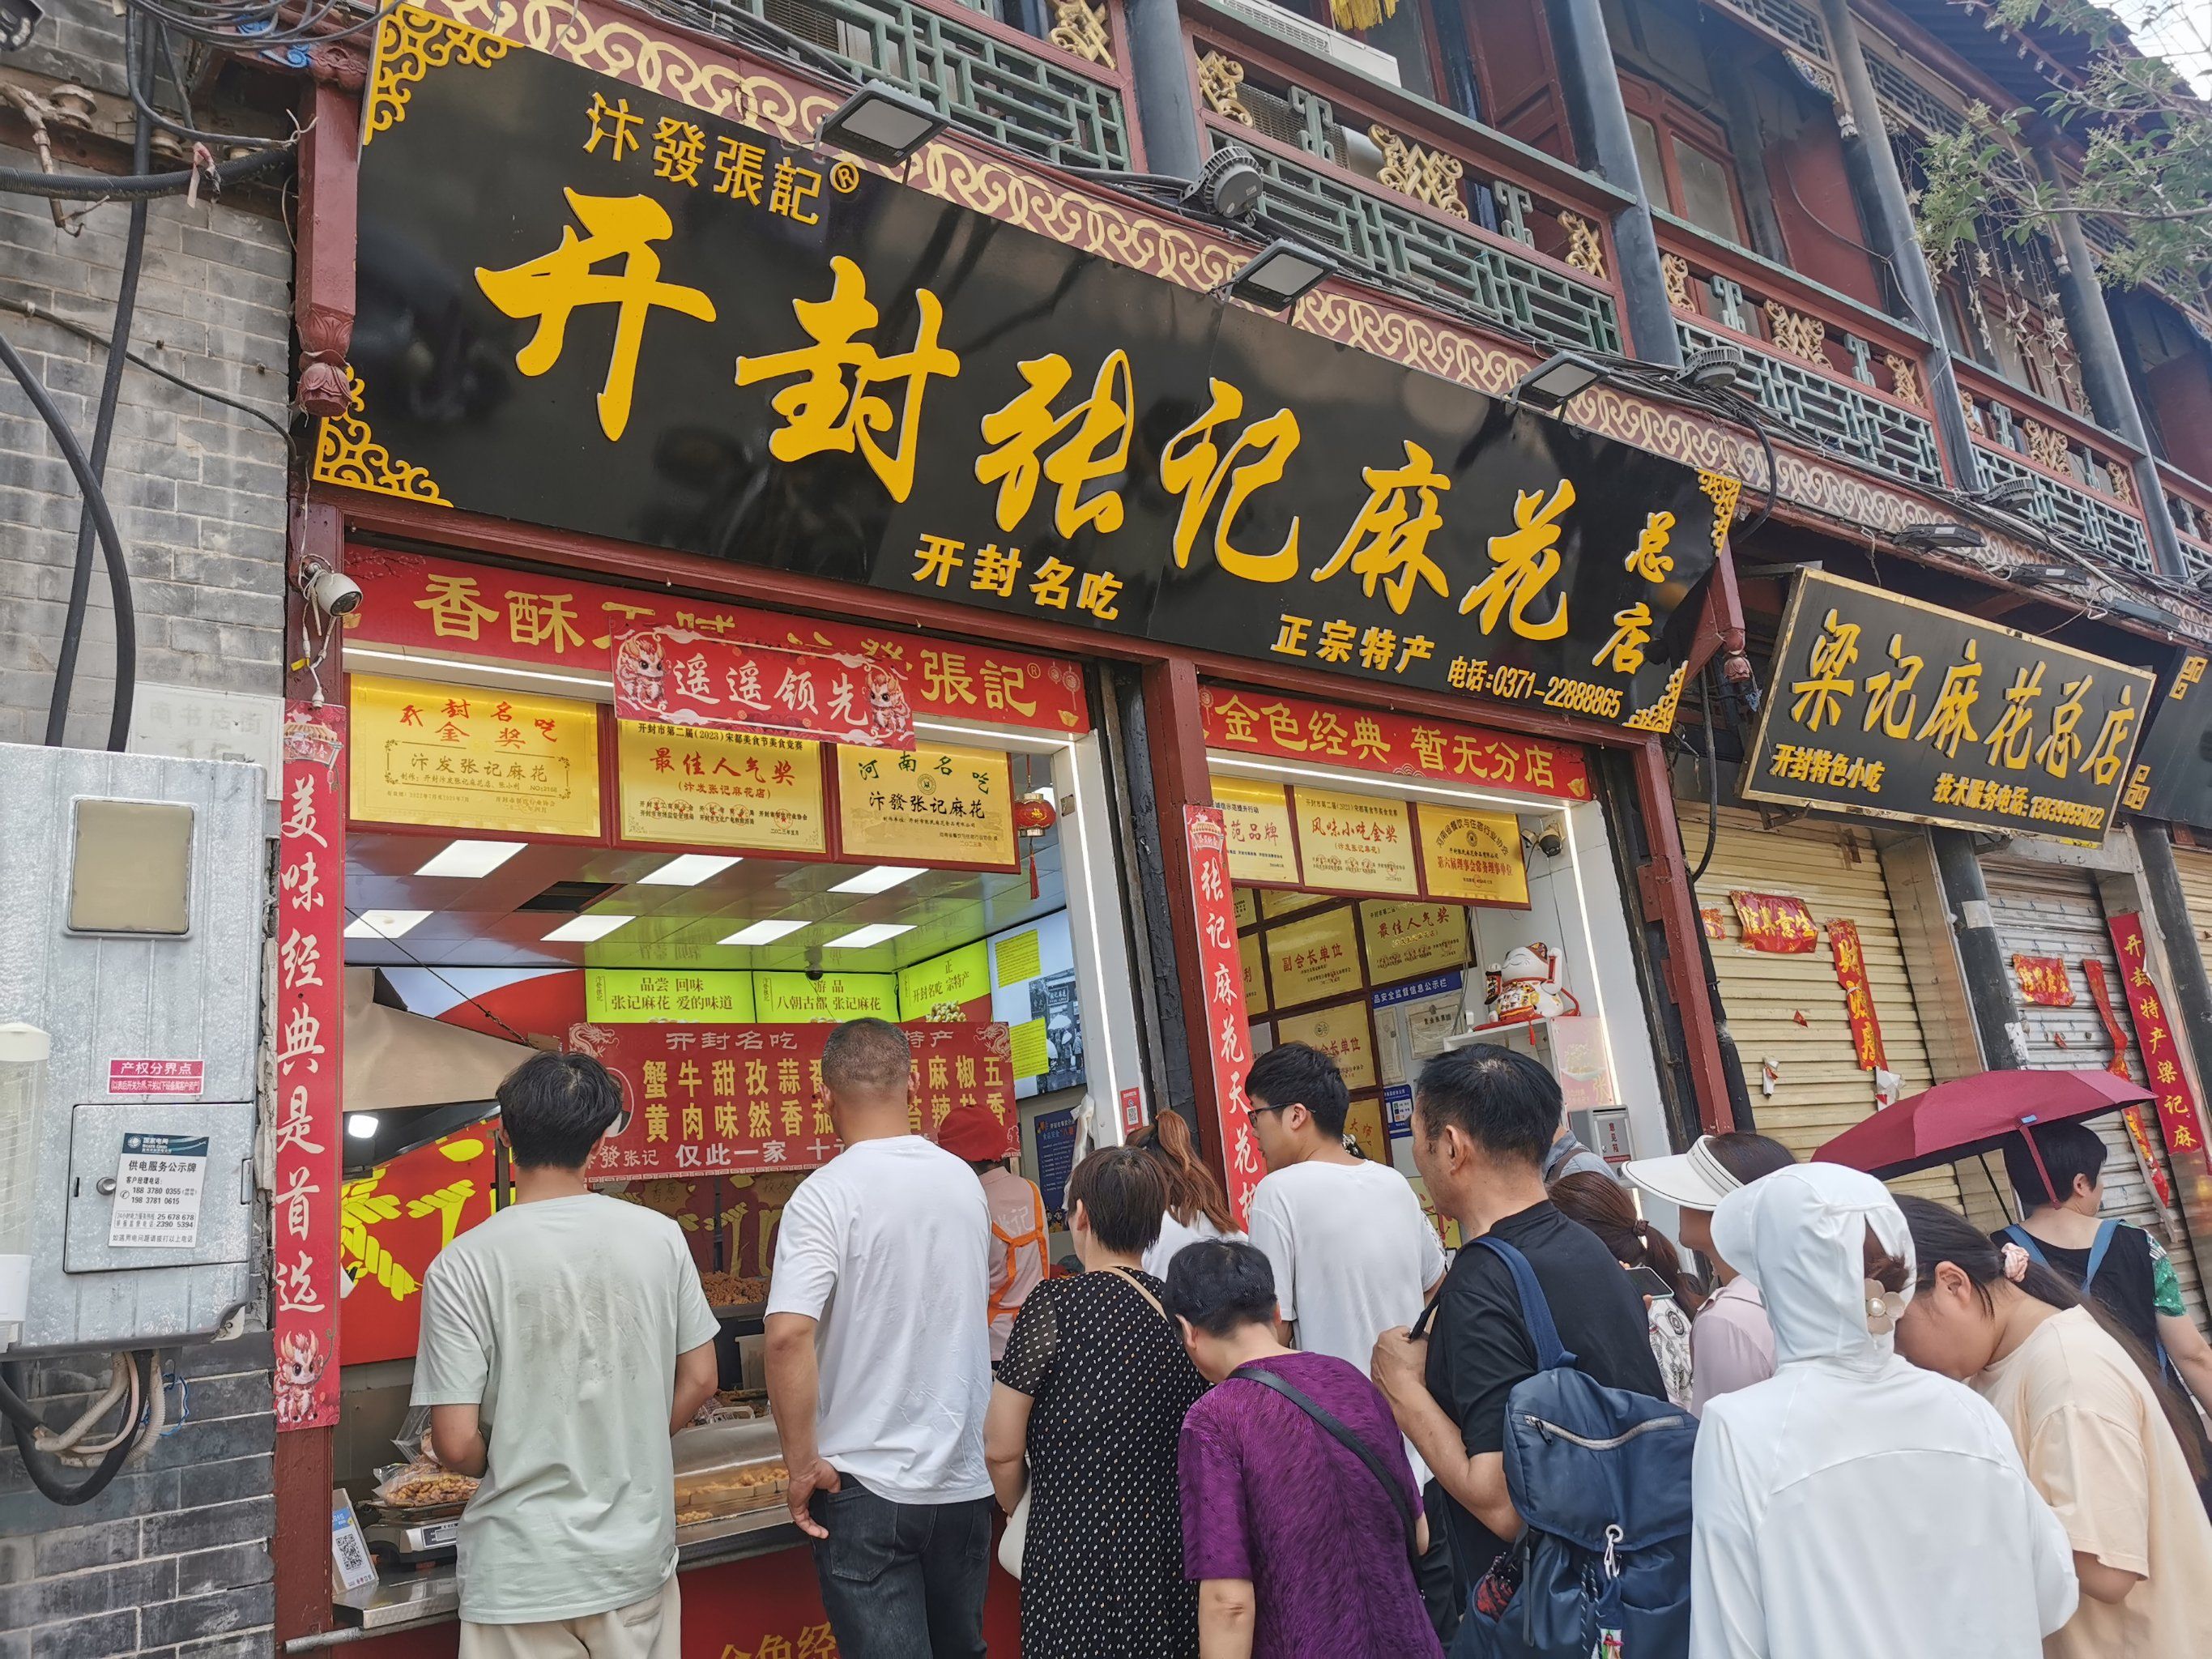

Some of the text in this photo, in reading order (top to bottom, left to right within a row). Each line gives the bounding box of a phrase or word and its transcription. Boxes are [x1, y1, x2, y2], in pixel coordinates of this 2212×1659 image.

[475, 186, 1576, 641] 开封张记麻花
[913, 533, 1124, 621] 开封名吃
[1592, 510, 1676, 675] 总店
[1270, 614, 1436, 675] 正宗特产
[672, 653, 870, 729] 遥遥领先
[1792, 608, 2135, 786] 梁记麻花总店
[399, 698, 558, 743] 开封名吃
[434, 721, 526, 750] 金奖
[1214, 693, 1555, 790] 金色经典 暂无分店
[411, 752, 549, 783] 汴发张记麻花
[649, 746, 796, 787] 最佳人气奖
[859, 751, 990, 795] 河南名吃
[1769, 743, 1886, 793] 开封特色小吃
[1224, 819, 1279, 847] 范品牌
[1311, 816, 1398, 844] 风味小吃金奖
[1377, 906, 1450, 940] 最佳人气奖
[1282, 942, 1343, 973] 副会长单位
[640, 977, 704, 992] 品尝 回味
[913, 981, 944, 1003] 开封名吃
[612, 995, 733, 1010] 张记麻花 爱的味道
[777, 996, 882, 1011] 八朝古都 张记麻花
[276, 772, 328, 1312] 美味经典是首选
[666, 1030, 799, 1051] 开封名吃
[1312, 1036, 1362, 1059] 会长单位
[2124, 933, 2197, 1149] 开封特产梁记麻
[120, 1061, 192, 1075] 产权分界点
[128, 1160, 197, 1173] 供电服务公示牌
[676, 1141, 788, 1168] 仅此一家
[147, 1187, 163, 1195] 3780
